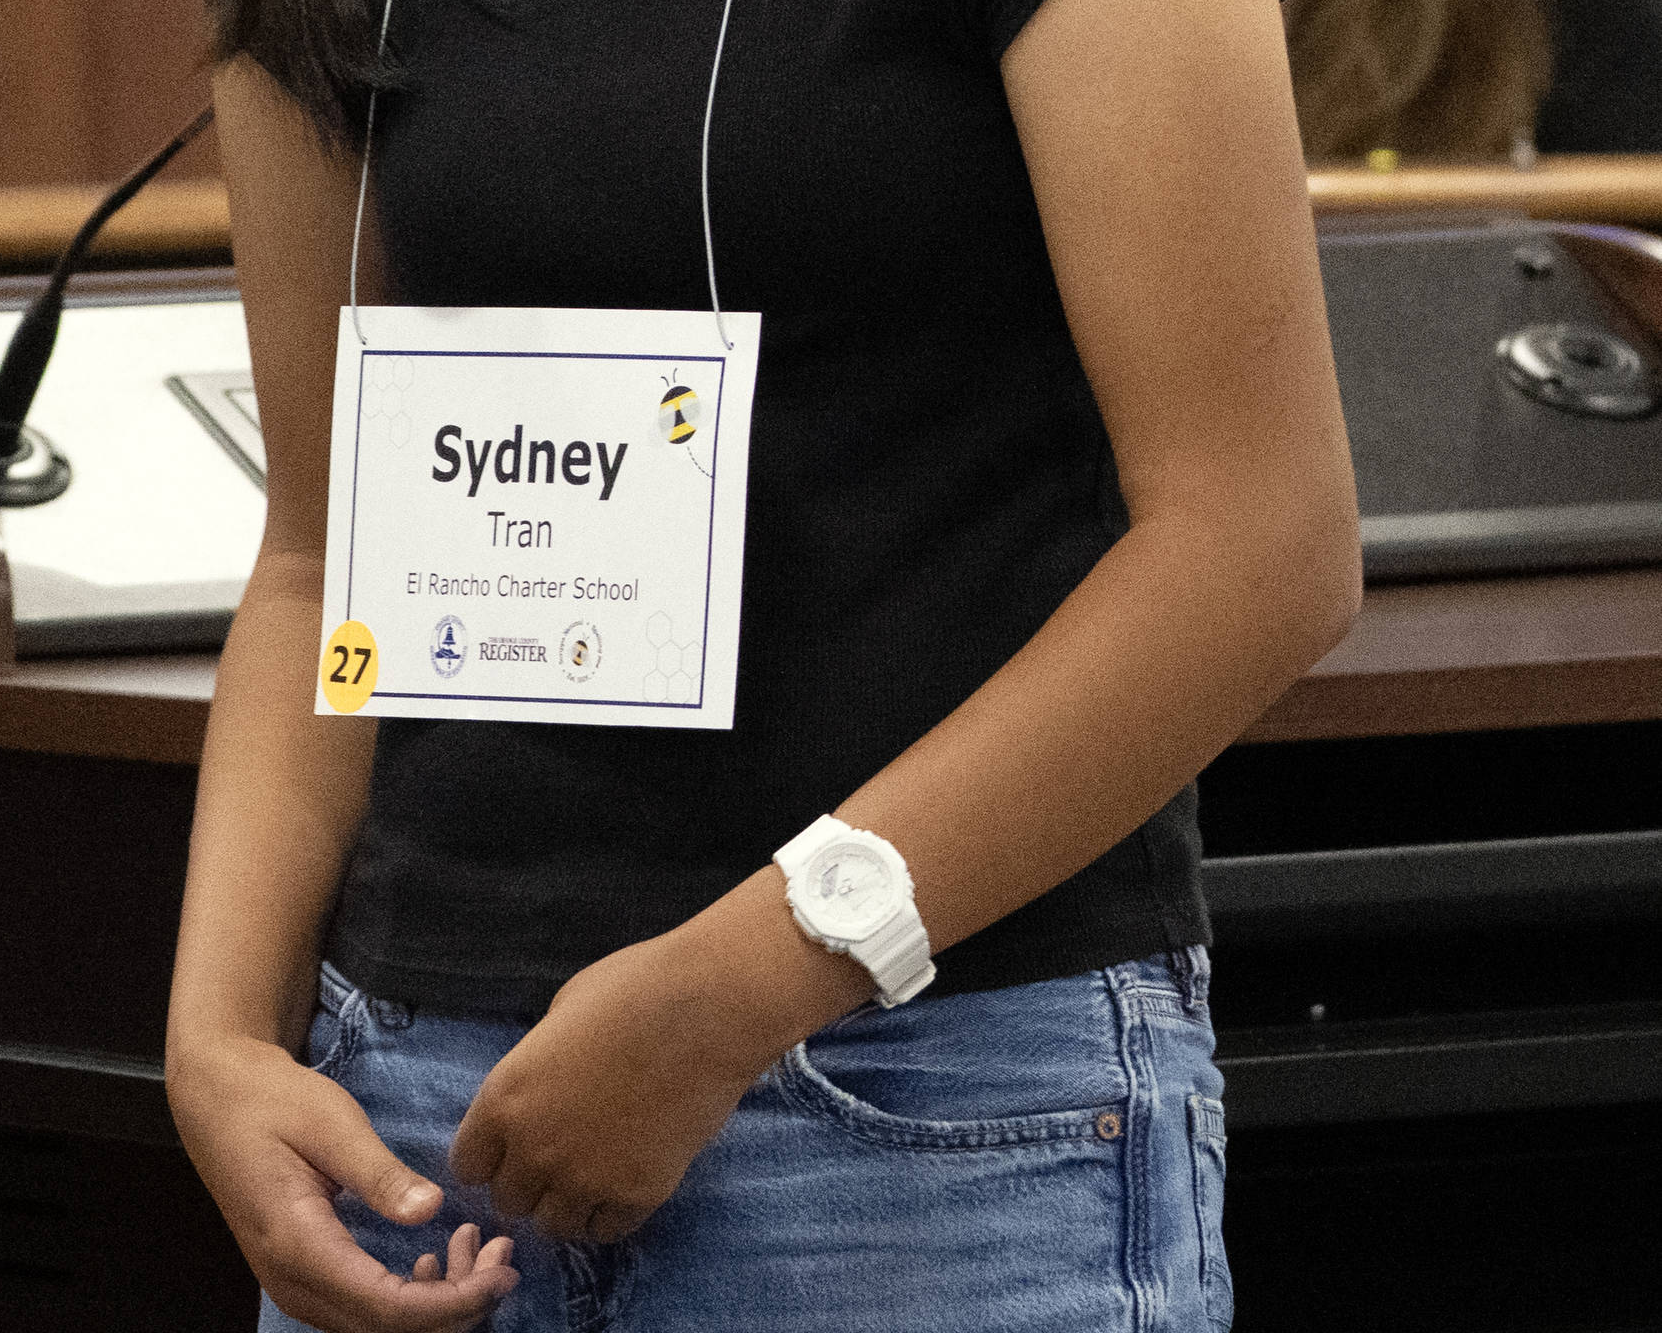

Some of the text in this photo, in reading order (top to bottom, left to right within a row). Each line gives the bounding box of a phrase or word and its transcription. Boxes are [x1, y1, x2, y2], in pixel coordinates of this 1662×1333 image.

[432, 424, 629, 501] Sydney
[487, 511, 552, 548] Tran
[406, 572, 639, 601] El Rancho Charter School
[329, 645, 372, 685] 27
[479, 641, 548, 663] REGISTER
